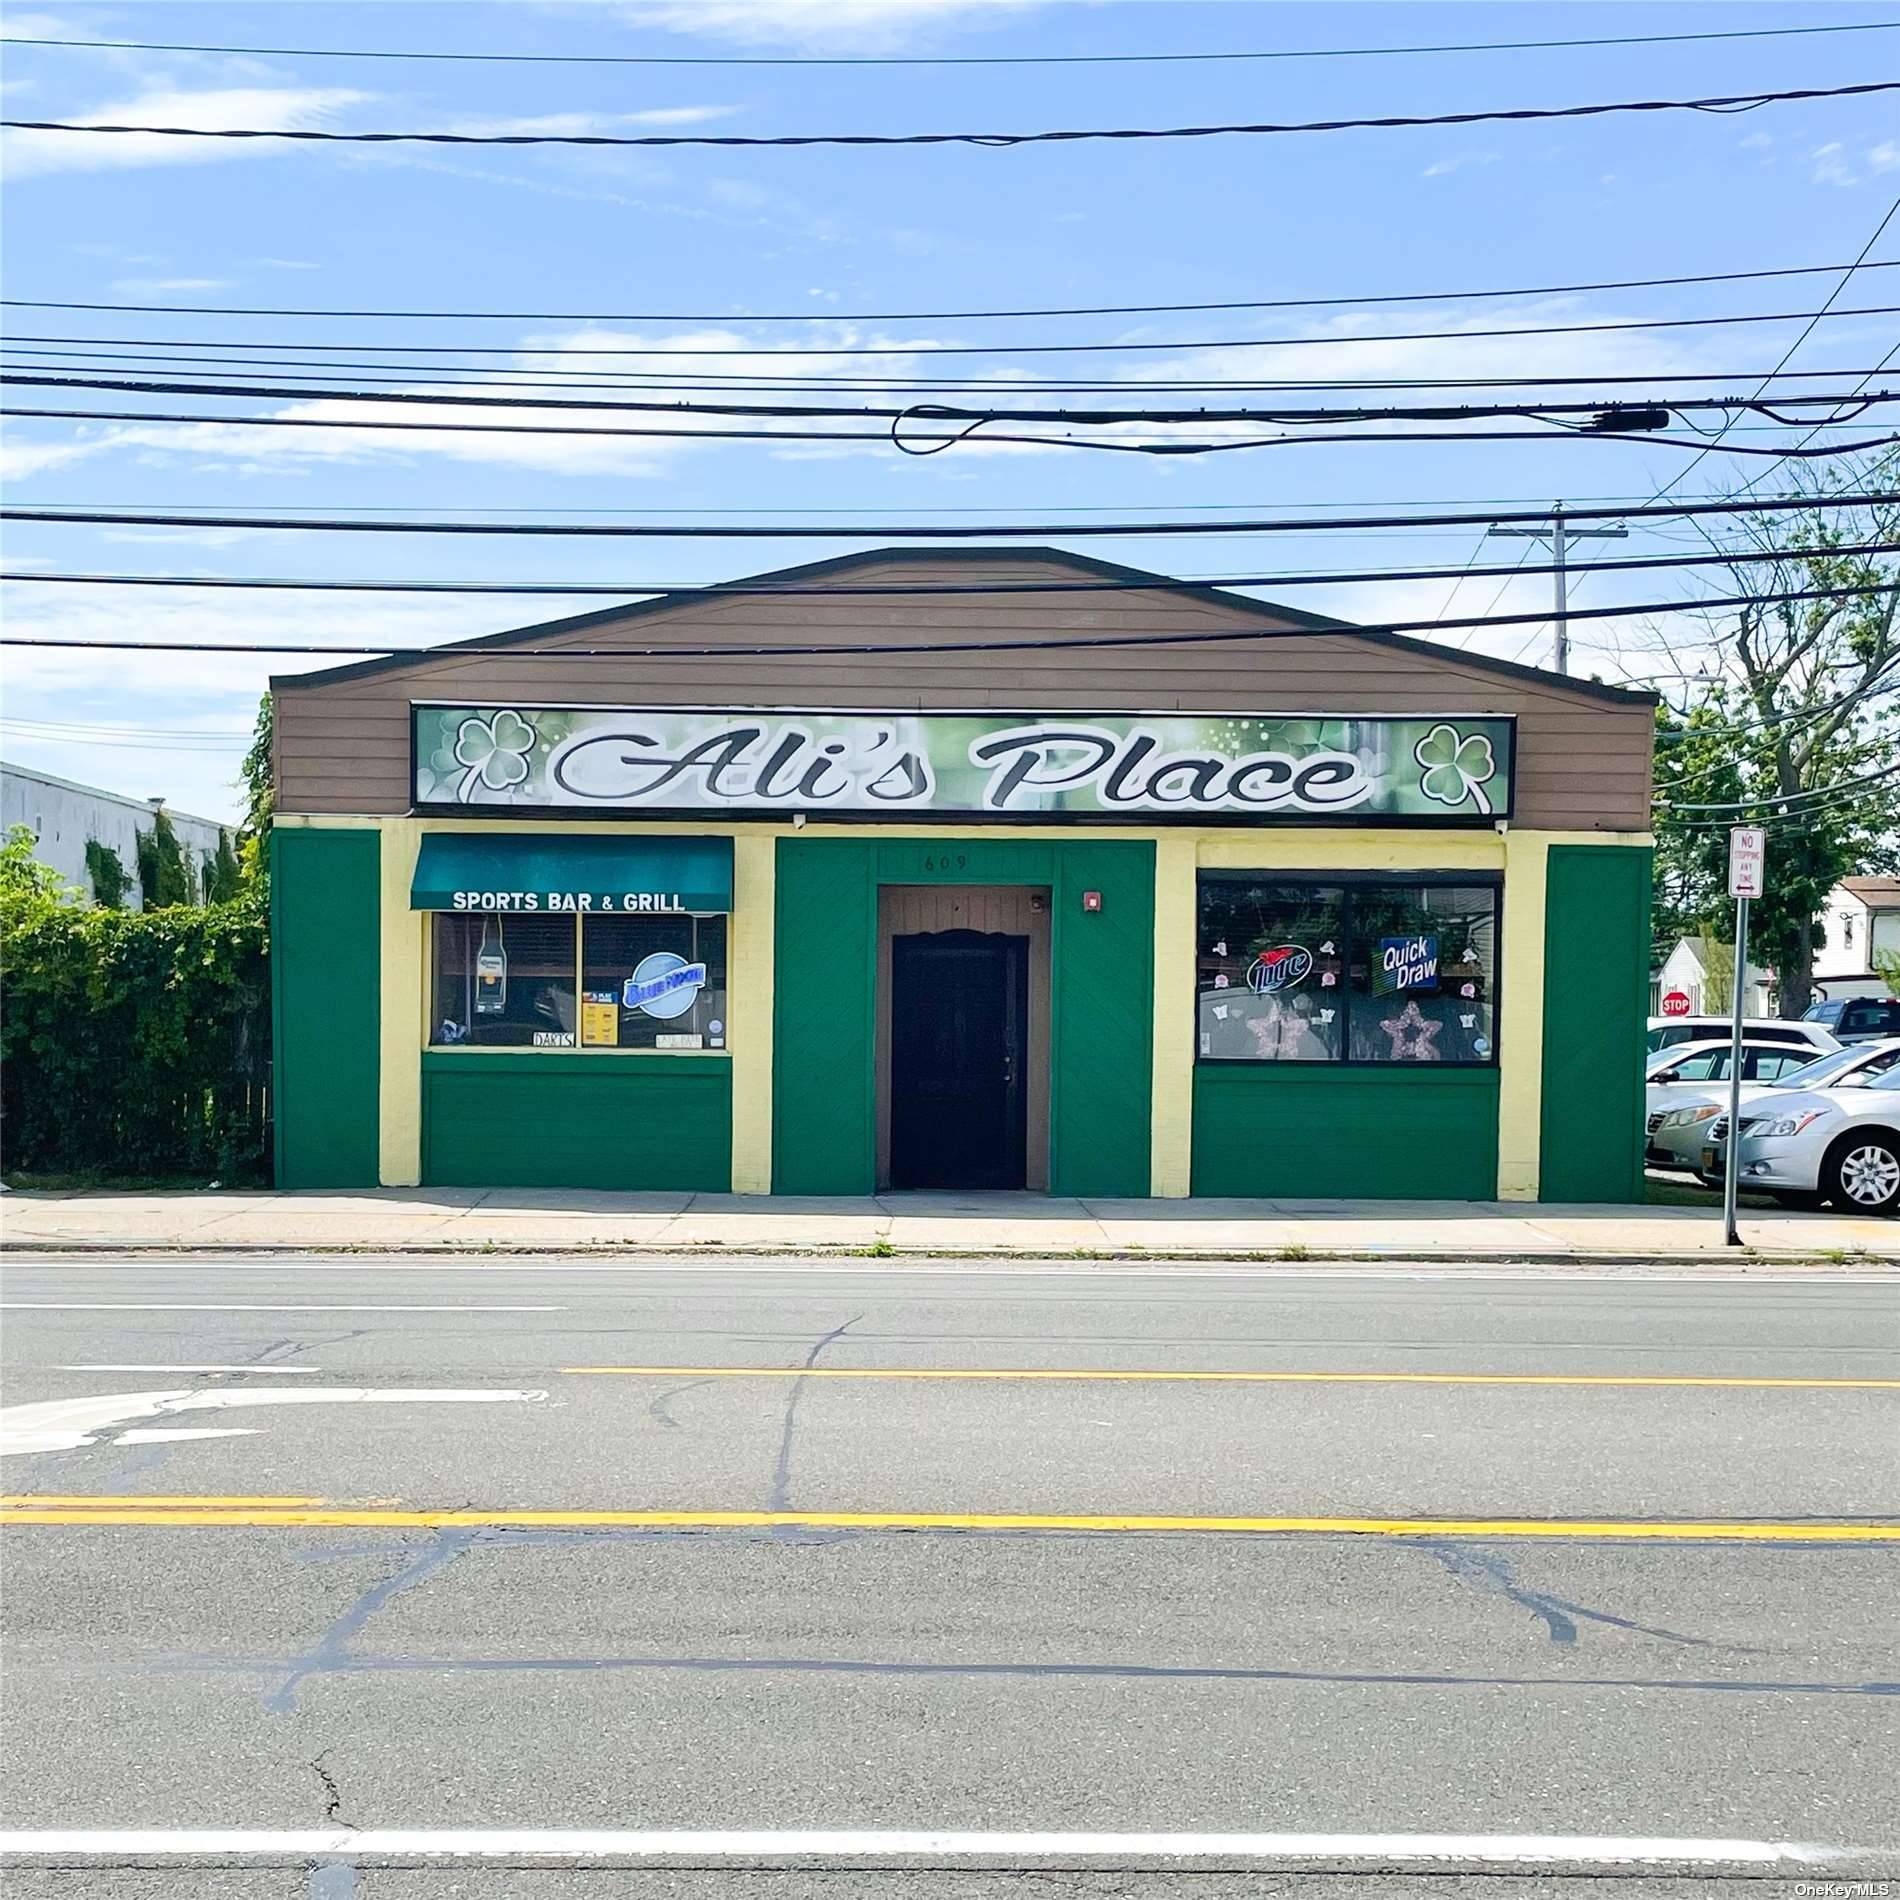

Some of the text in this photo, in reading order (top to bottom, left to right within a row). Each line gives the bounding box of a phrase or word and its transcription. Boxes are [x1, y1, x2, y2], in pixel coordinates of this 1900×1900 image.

[553, 727, 1369, 808] Ali's Place
[1741, 835, 1754, 849] NO
[924, 855, 967, 871] 609
[452, 891, 685, 912] SPORTS BAR & GRILL
[1383, 935, 1427, 971] Quick
[1397, 958, 1438, 990] Draw
[1663, 999, 1689, 1011] STOP
[535, 1032, 574, 1047] DARTS
